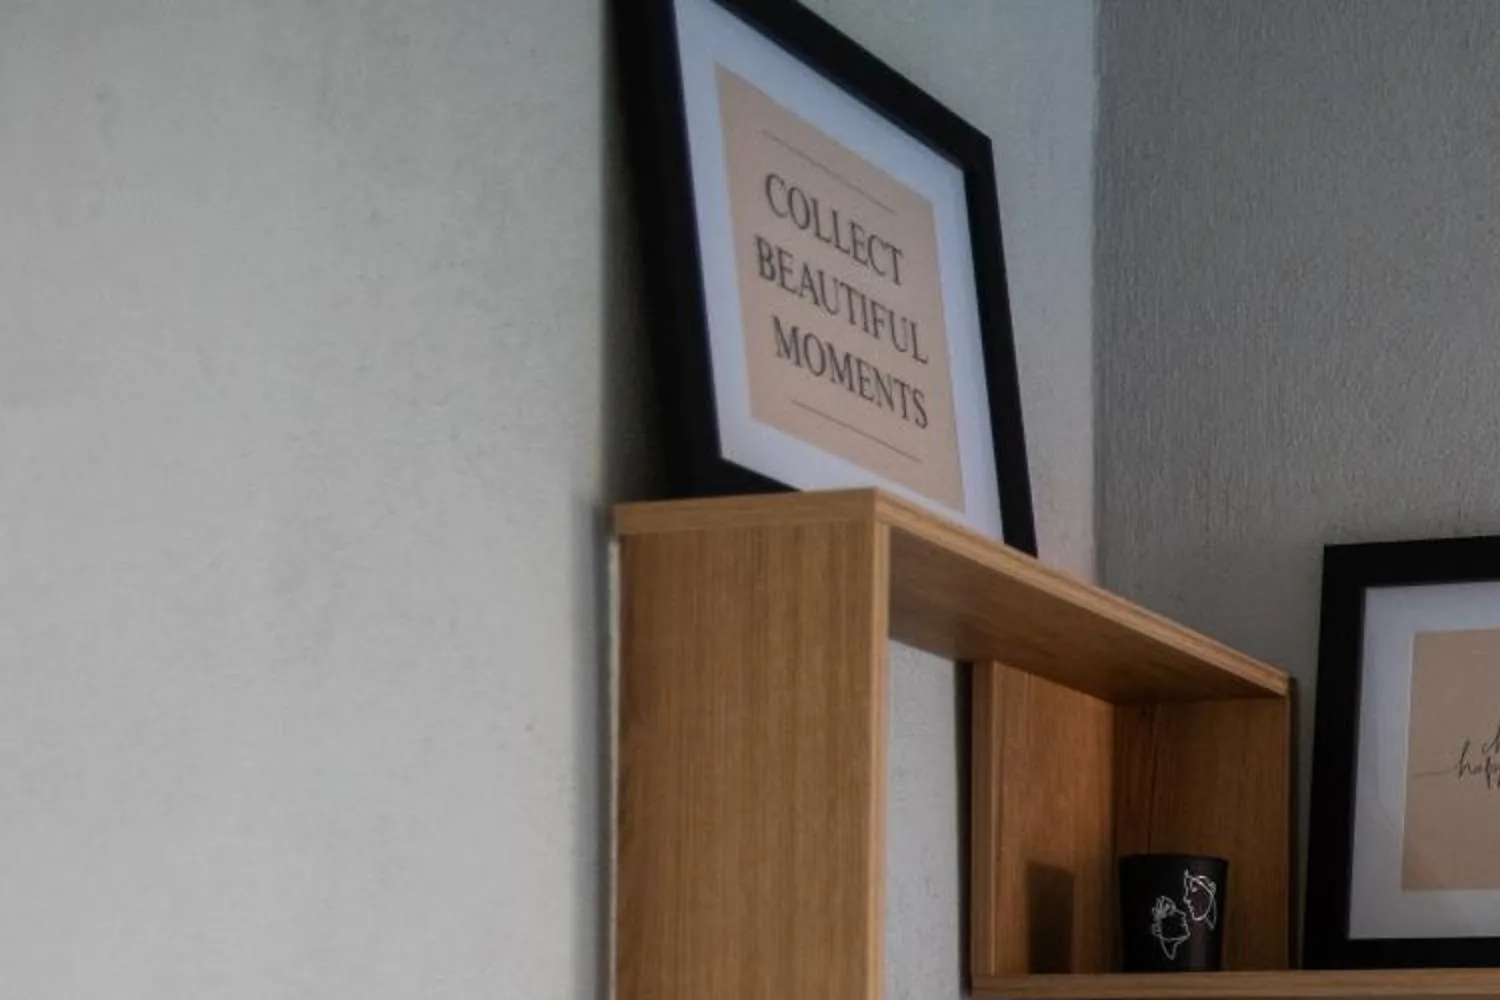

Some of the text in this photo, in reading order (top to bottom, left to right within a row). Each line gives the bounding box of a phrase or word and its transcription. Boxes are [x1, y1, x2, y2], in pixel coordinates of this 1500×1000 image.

[764, 172, 903, 285] COLLECT
[754, 233, 928, 364] BEAUTIFUL
[771, 314, 928, 429] MOMENTS
